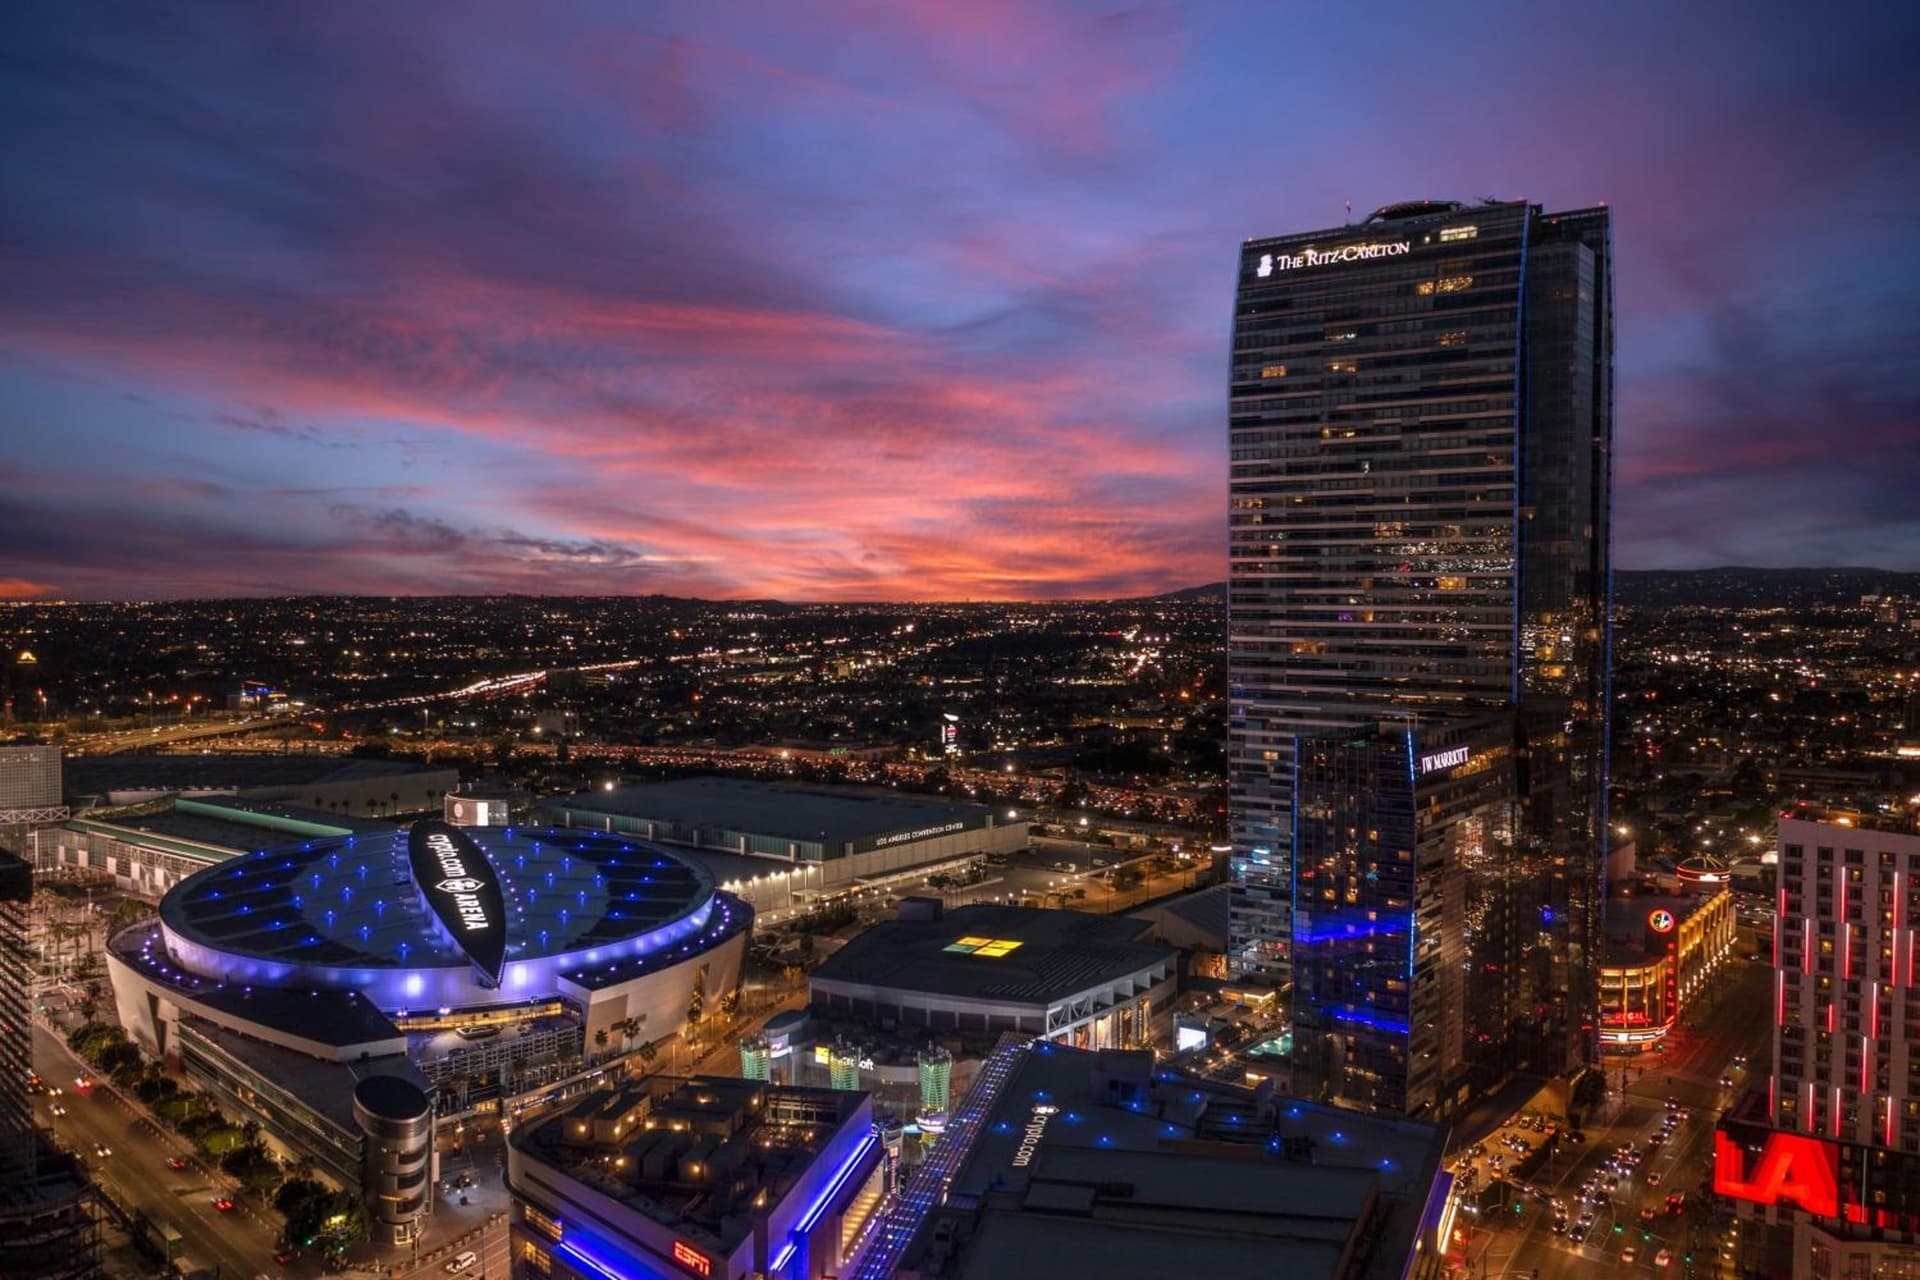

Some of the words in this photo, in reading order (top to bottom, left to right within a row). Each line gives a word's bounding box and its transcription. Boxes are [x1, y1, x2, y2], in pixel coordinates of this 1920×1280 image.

[1277, 255, 1304, 271] THE
[1307, 241, 1410, 267] RITZ-CARLTON
[1421, 756, 1433, 775] JW
[1433, 746, 1469, 770] MARRIOTT
[426, 834, 467, 878] crypto.com
[454, 893, 489, 930] ARENA
[1012, 1115, 1048, 1167] crypto.com
[1714, 1130, 1839, 1218] LA
[675, 1241, 710, 1276] ESPN
